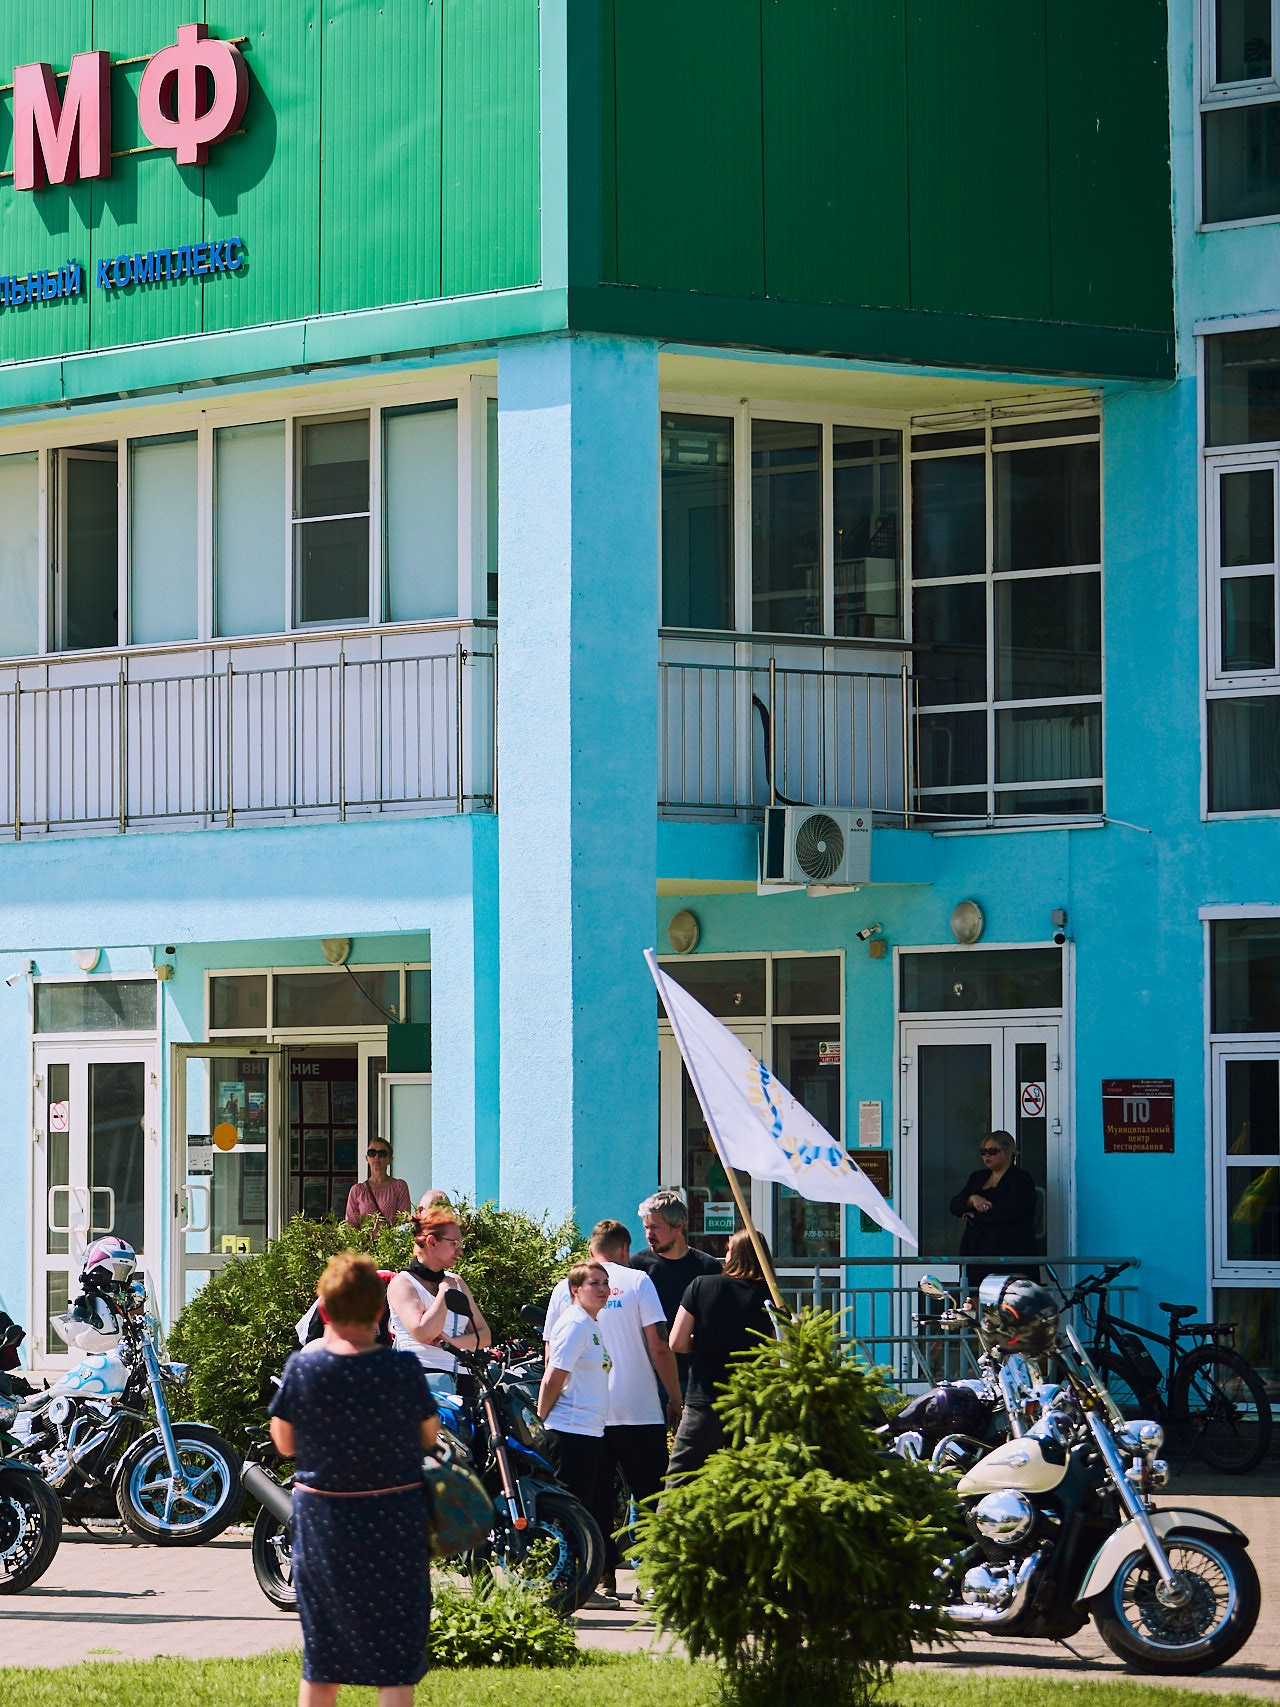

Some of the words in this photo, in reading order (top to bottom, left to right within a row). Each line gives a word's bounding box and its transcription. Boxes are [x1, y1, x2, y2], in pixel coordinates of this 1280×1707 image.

[96, 235, 244, 289] КОМПЛЕКС
[1123, 1098, 1150, 1123] ГТО
[1106, 1124, 1170, 1135] Муниципальный
[1128, 1135, 1150, 1143] центр
[1113, 1143, 1164, 1152] тестирования
[708, 1219, 732, 1228] ВХОД
